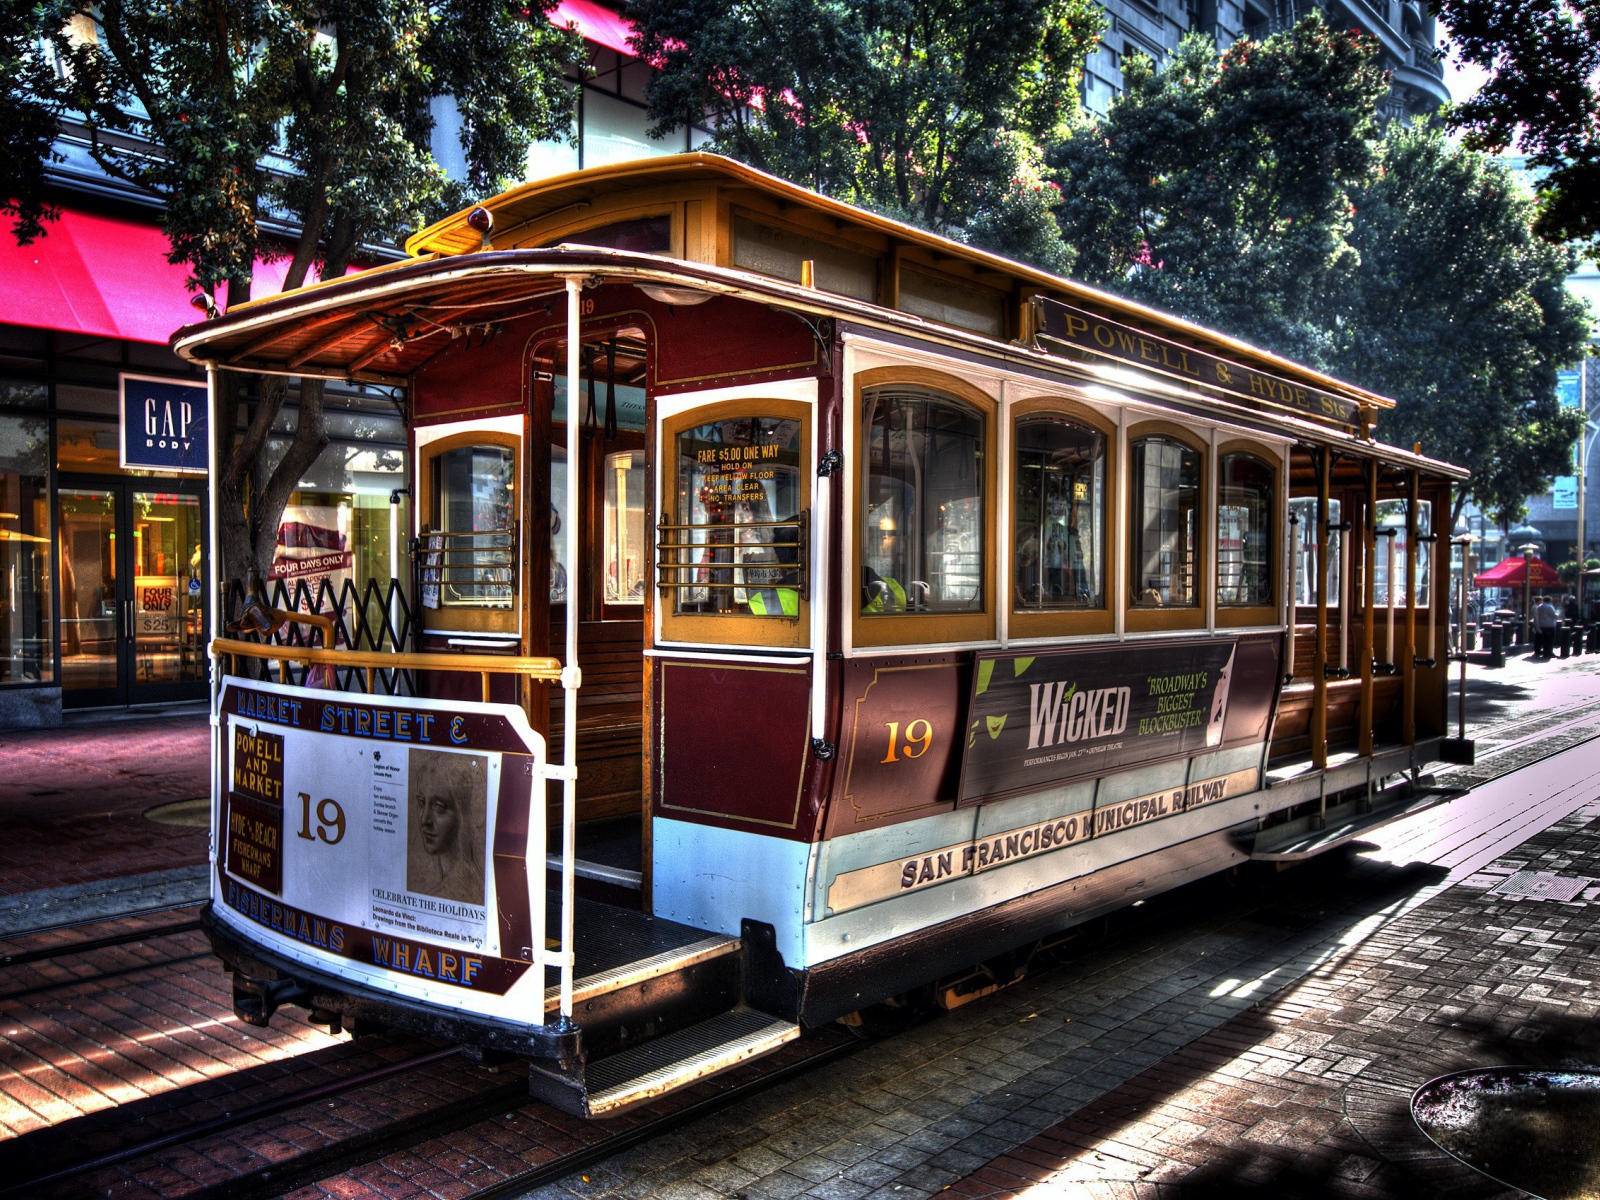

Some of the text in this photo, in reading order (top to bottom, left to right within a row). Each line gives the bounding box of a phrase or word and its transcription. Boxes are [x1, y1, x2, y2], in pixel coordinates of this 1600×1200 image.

[581, 298, 594, 315] 19
[1064, 312, 1200, 377] POWELL
[1215, 361, 1234, 386] &
[1249, 373, 1311, 409] HYDE
[145, 398, 192, 438] GAP
[146, 438, 190, 450] BODY
[698, 444, 779, 463] FARE $5.00 ONE WAY
[702, 470, 774, 482] KEEP YELLOW FLOOR
[722, 462, 740, 471] HOLD
[724, 492, 764, 501] TRANSFERS
[736, 482, 760, 491] CLEAR
[274, 554, 344, 575] FOUR DAYS ONLY
[144, 588, 172, 596] FOUR
[143, 602, 172, 611] ONLY
[144, 620, 169, 631] $25
[1156, 692, 1196, 714] BIGGEST
[237, 692, 302, 726] MARKET
[320, 703, 435, 742] STREET
[1026, 681, 1132, 750] WICKED
[236, 732, 282, 763] POWELL
[880, 718, 933, 764] 19
[246, 757, 268, 774] AND
[1023, 754, 1056, 767] PERFORMANCES
[234, 766, 282, 799] MARKET
[296, 791, 346, 846] 19
[230, 812, 246, 837] HYDE
[254, 821, 277, 850] BEACH
[901, 778, 1228, 888] SAN FRANCISCO MUNICIPAL RAILWAY
[233, 838, 272, 868] FISHERMANS
[241, 858, 262, 880] WHARF
[372, 888, 486, 920] CELEBRATE THE HOLIDAYS
[372, 904, 394, 916] Leonardo
[402, 912, 416, 922] Vinci:
[228, 881, 482, 986] FISHERMANS WHARF
[372, 913, 394, 925] Drawings
[394, 918, 406, 928] from
[407, 922, 416, 930] the
[416, 924, 443, 937] Biblioteca
[444, 931, 460, 940] Reale
